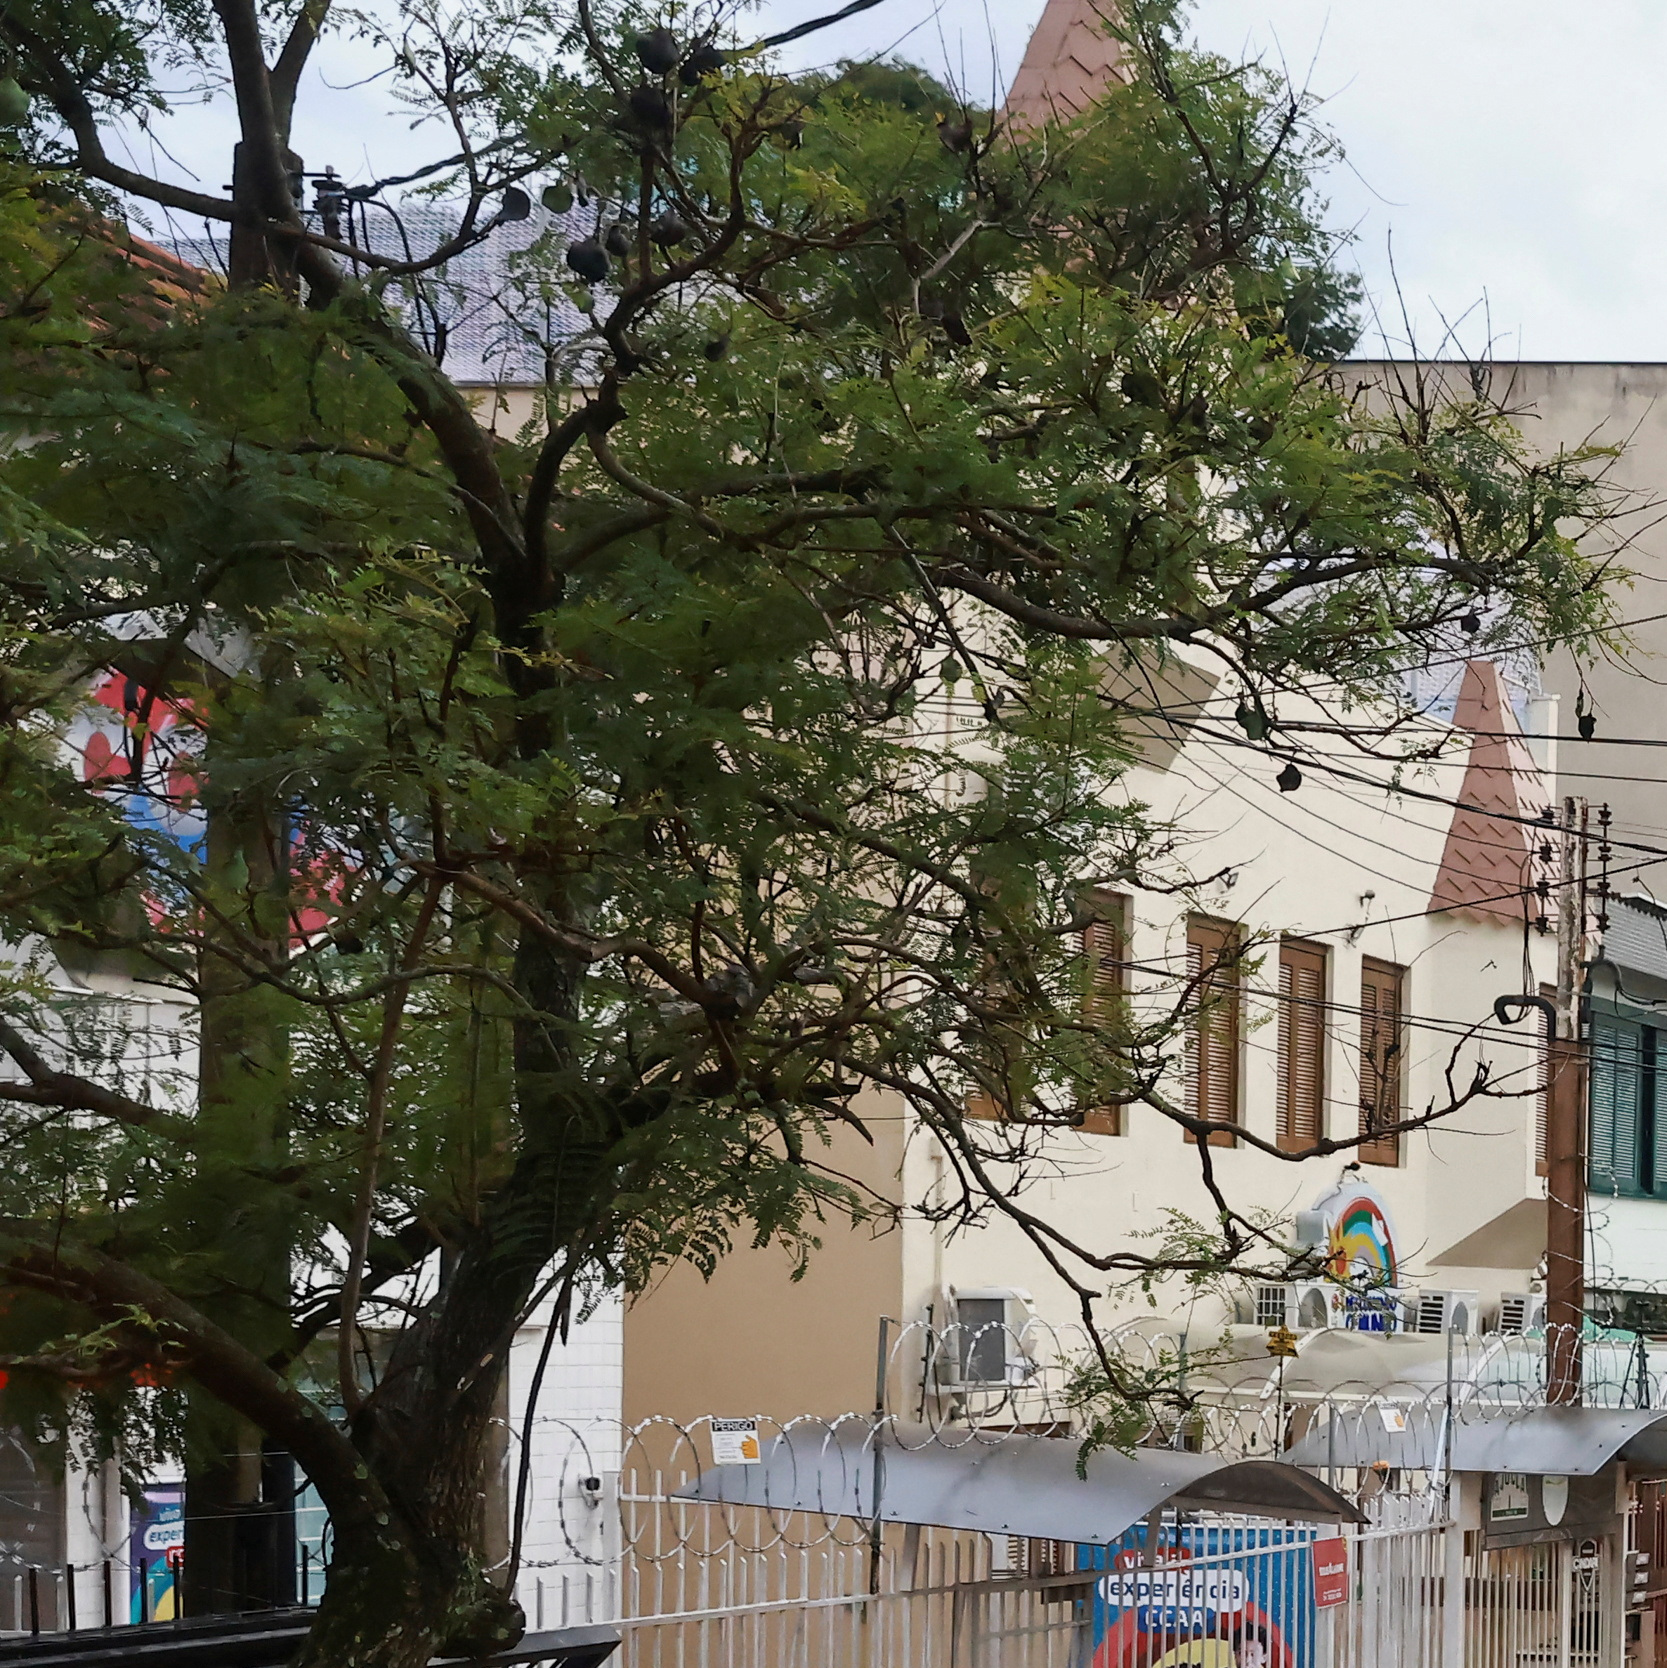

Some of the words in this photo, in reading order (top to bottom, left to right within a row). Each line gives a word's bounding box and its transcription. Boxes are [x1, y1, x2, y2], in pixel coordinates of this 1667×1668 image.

[714, 1421, 753, 1431] PERIGO
[1124, 1551, 1164, 1569] via
[1110, 1579, 1240, 1601] experência
[1145, 1609, 1204, 1628] CCAA
